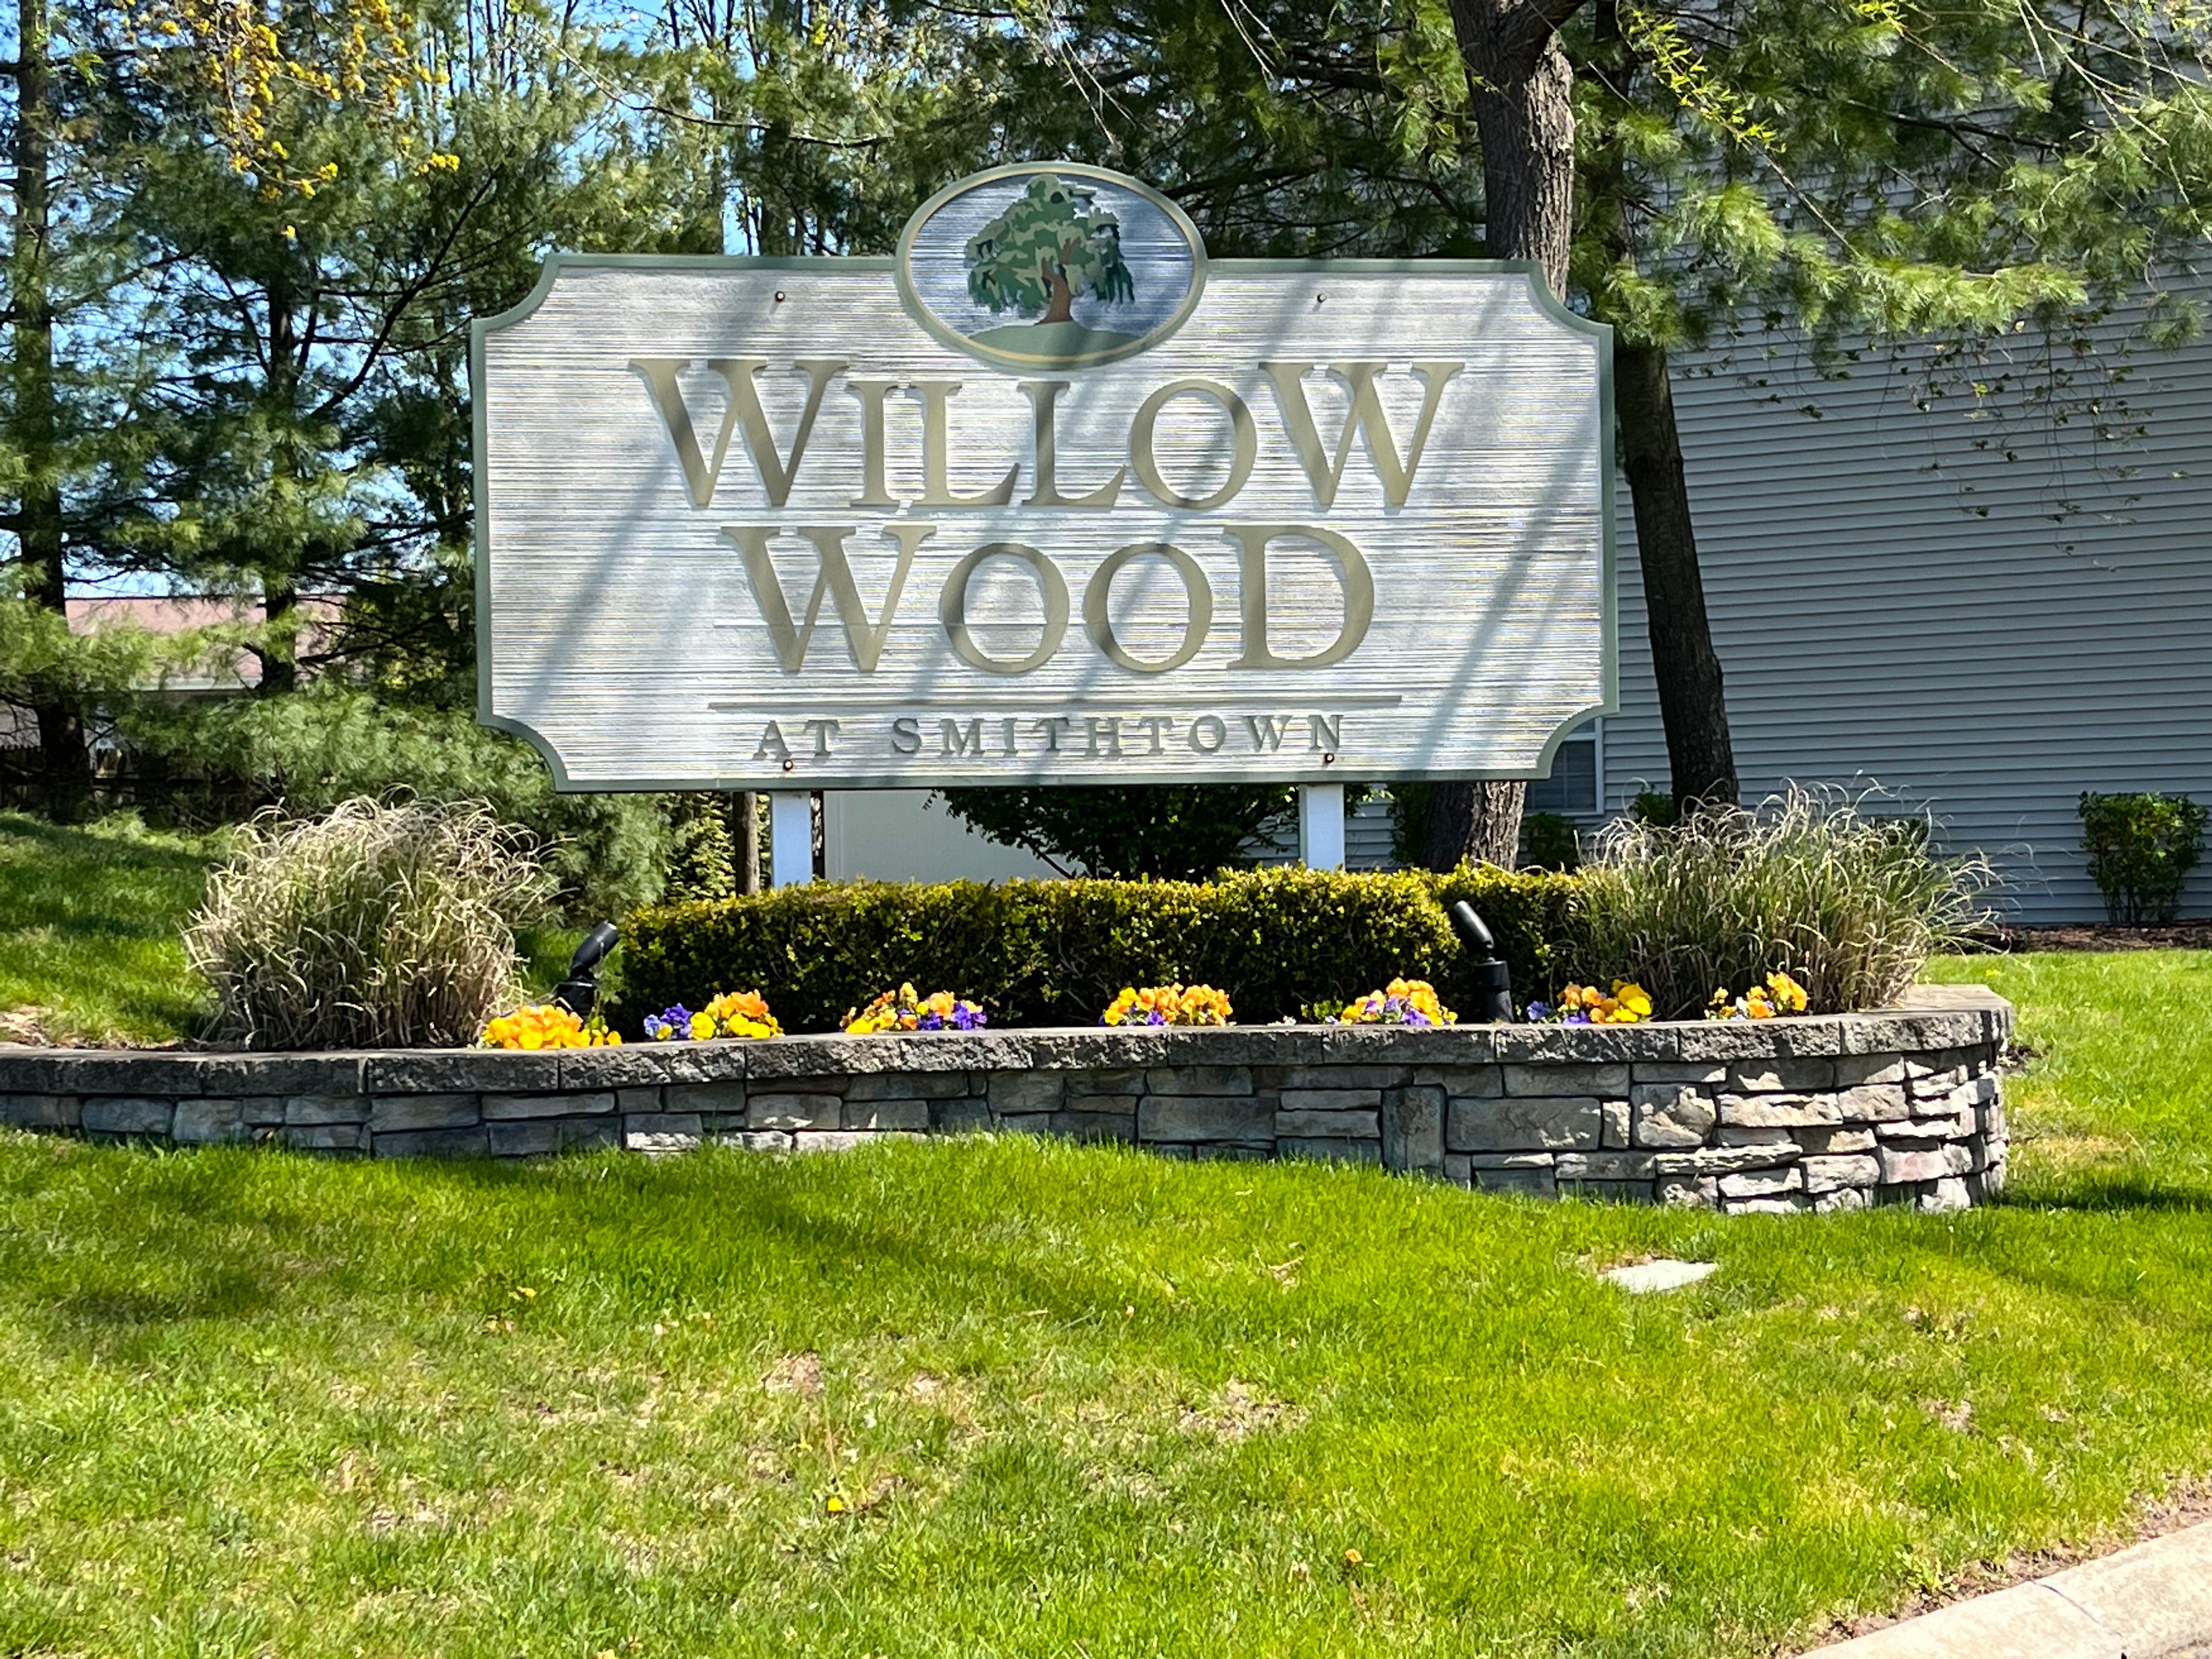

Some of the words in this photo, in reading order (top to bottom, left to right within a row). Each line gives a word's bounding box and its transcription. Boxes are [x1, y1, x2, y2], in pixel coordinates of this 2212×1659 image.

[629, 359, 1465, 510] WILLOW
[720, 525, 1375, 674] WOOD
[753, 719, 840, 759] AT
[891, 715, 1344, 758] SMITHTOWN
